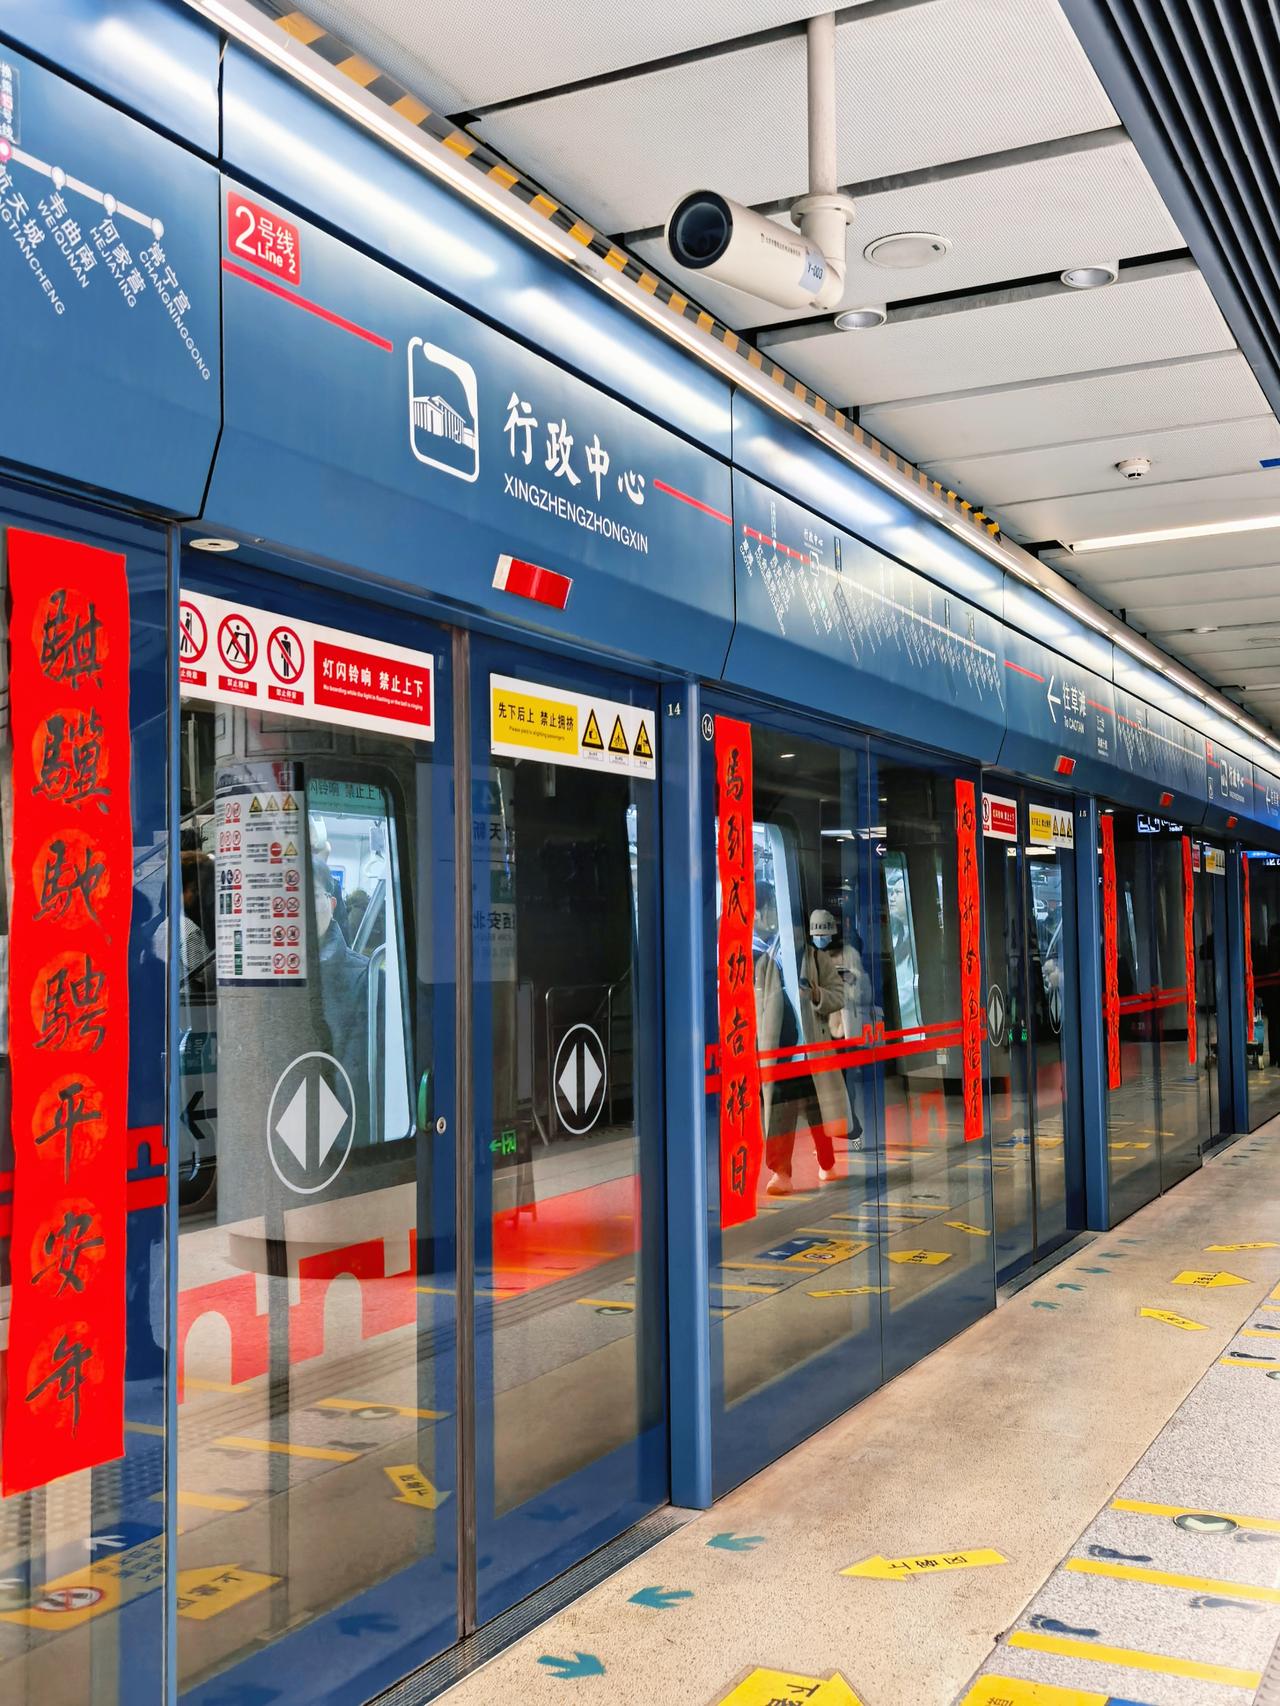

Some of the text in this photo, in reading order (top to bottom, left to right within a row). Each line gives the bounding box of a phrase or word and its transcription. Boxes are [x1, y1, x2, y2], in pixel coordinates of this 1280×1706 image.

[37, 199, 90, 289] WEIQUNAN
[49, 191, 98, 273] 韦曲南
[89, 227, 137, 308] HEJIAYING
[98, 218, 147, 295] 何家营
[257, 241, 297, 275] Line 2
[139, 250, 211, 381] CHANGNINGGONG
[149, 242, 192, 316] 常宁宫
[503, 391, 646, 506] 行政中心
[503, 472, 649, 555] XINGZHENGZHONGXIN
[322, 657, 425, 699] 灯闪铃响 禁止上下
[667, 702, 682, 717] 14
[497, 701, 575, 733] 先下后上 禁止拥挤
[703, 720, 713, 735] 14
